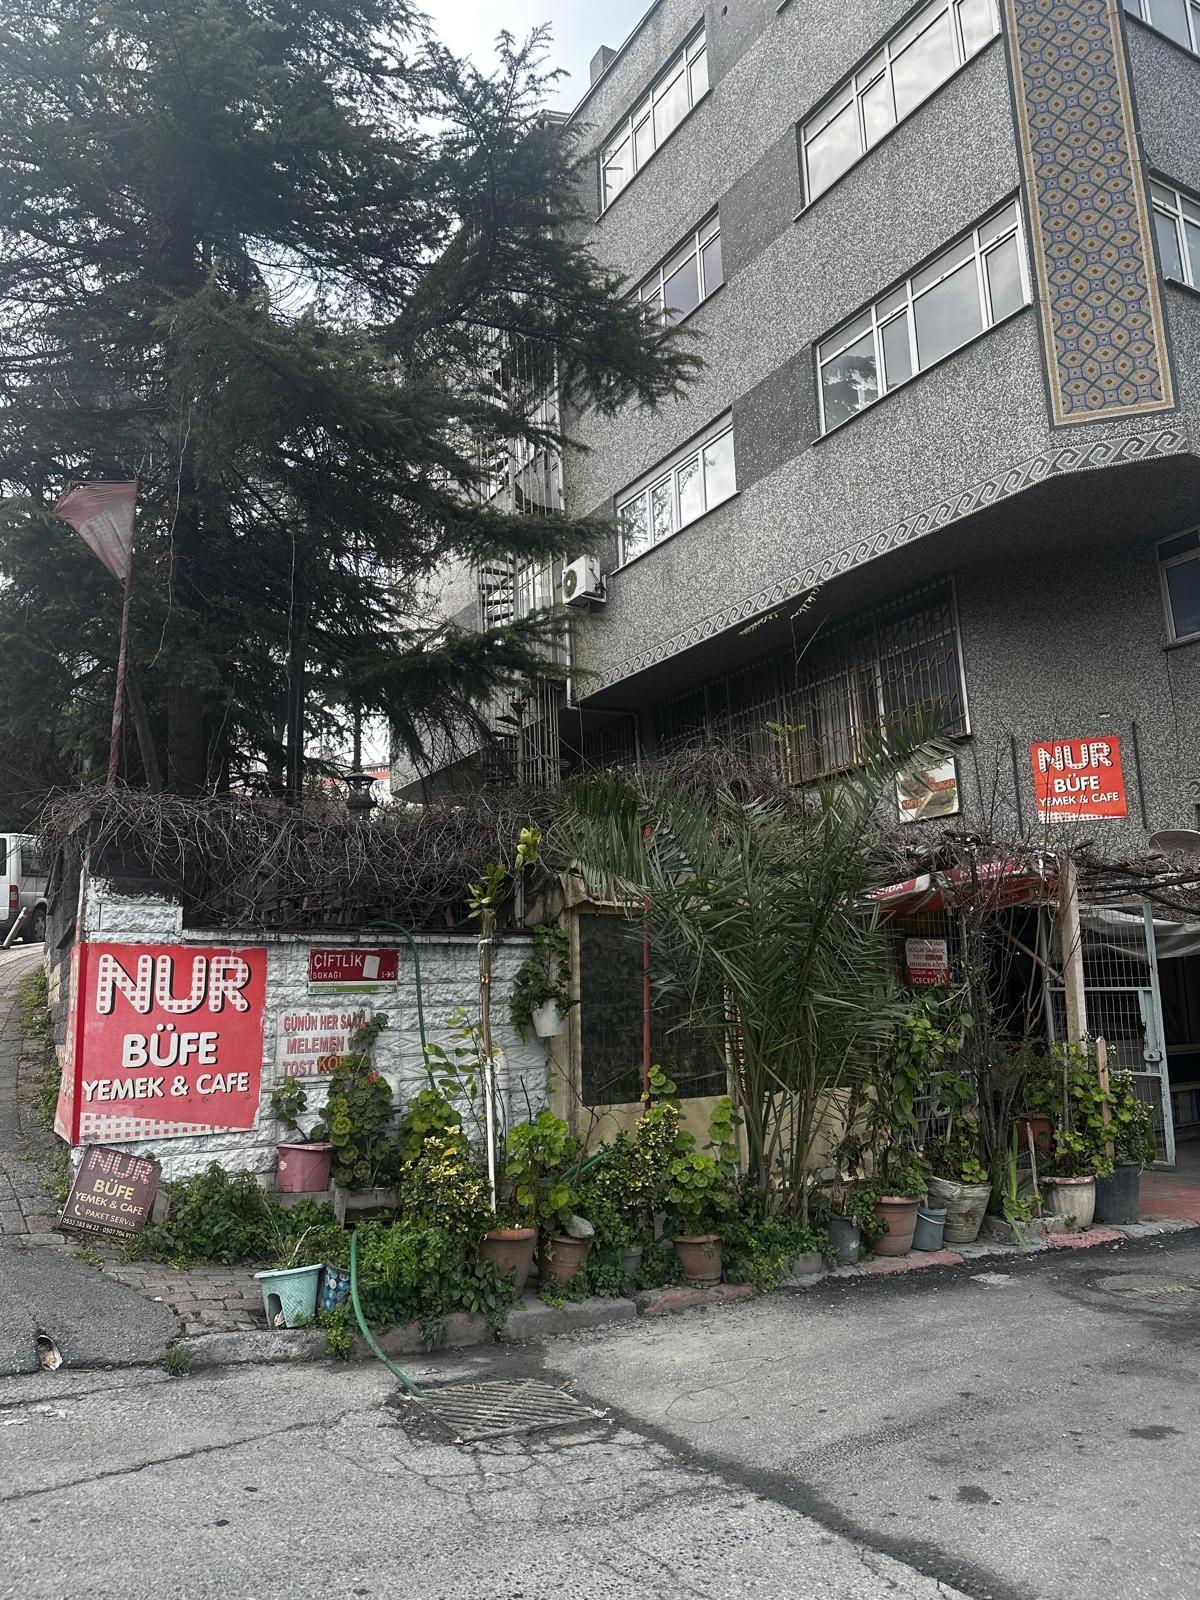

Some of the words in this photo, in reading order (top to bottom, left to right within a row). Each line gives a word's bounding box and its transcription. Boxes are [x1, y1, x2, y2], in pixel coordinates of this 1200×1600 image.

[1037, 742, 1112, 773] NUR
[931, 779, 956, 791] BURGER
[1054, 773, 1100, 793] BÜFE
[1039, 796, 1077, 807] YEMEK
[1079, 794, 1088, 804] &
[1091, 791, 1119, 803] CAFE
[314, 952, 363, 969] ÇİFTLİK
[96, 953, 251, 1014] NUR
[312, 970, 342, 980] SOKAĞI
[284, 1013, 317, 1031] GÜNÜN
[320, 1014, 339, 1030] HER
[122, 1023, 219, 1068] BÜFE
[287, 1036, 345, 1054] MELEMEN
[282, 1060, 314, 1076] TOST
[82, 1076, 164, 1102] YEMEK
[171, 1076, 189, 1097] &
[196, 1072, 249, 1094] CAFE
[88, 1148, 153, 1184] NUR
[93, 1178, 135, 1201] BÜFE
[75, 1191, 108, 1207] YEMEK
[109, 1200, 118, 1209] &
[120, 1202, 144, 1216] CAFE
[85, 1208, 110, 1221] PAKET
